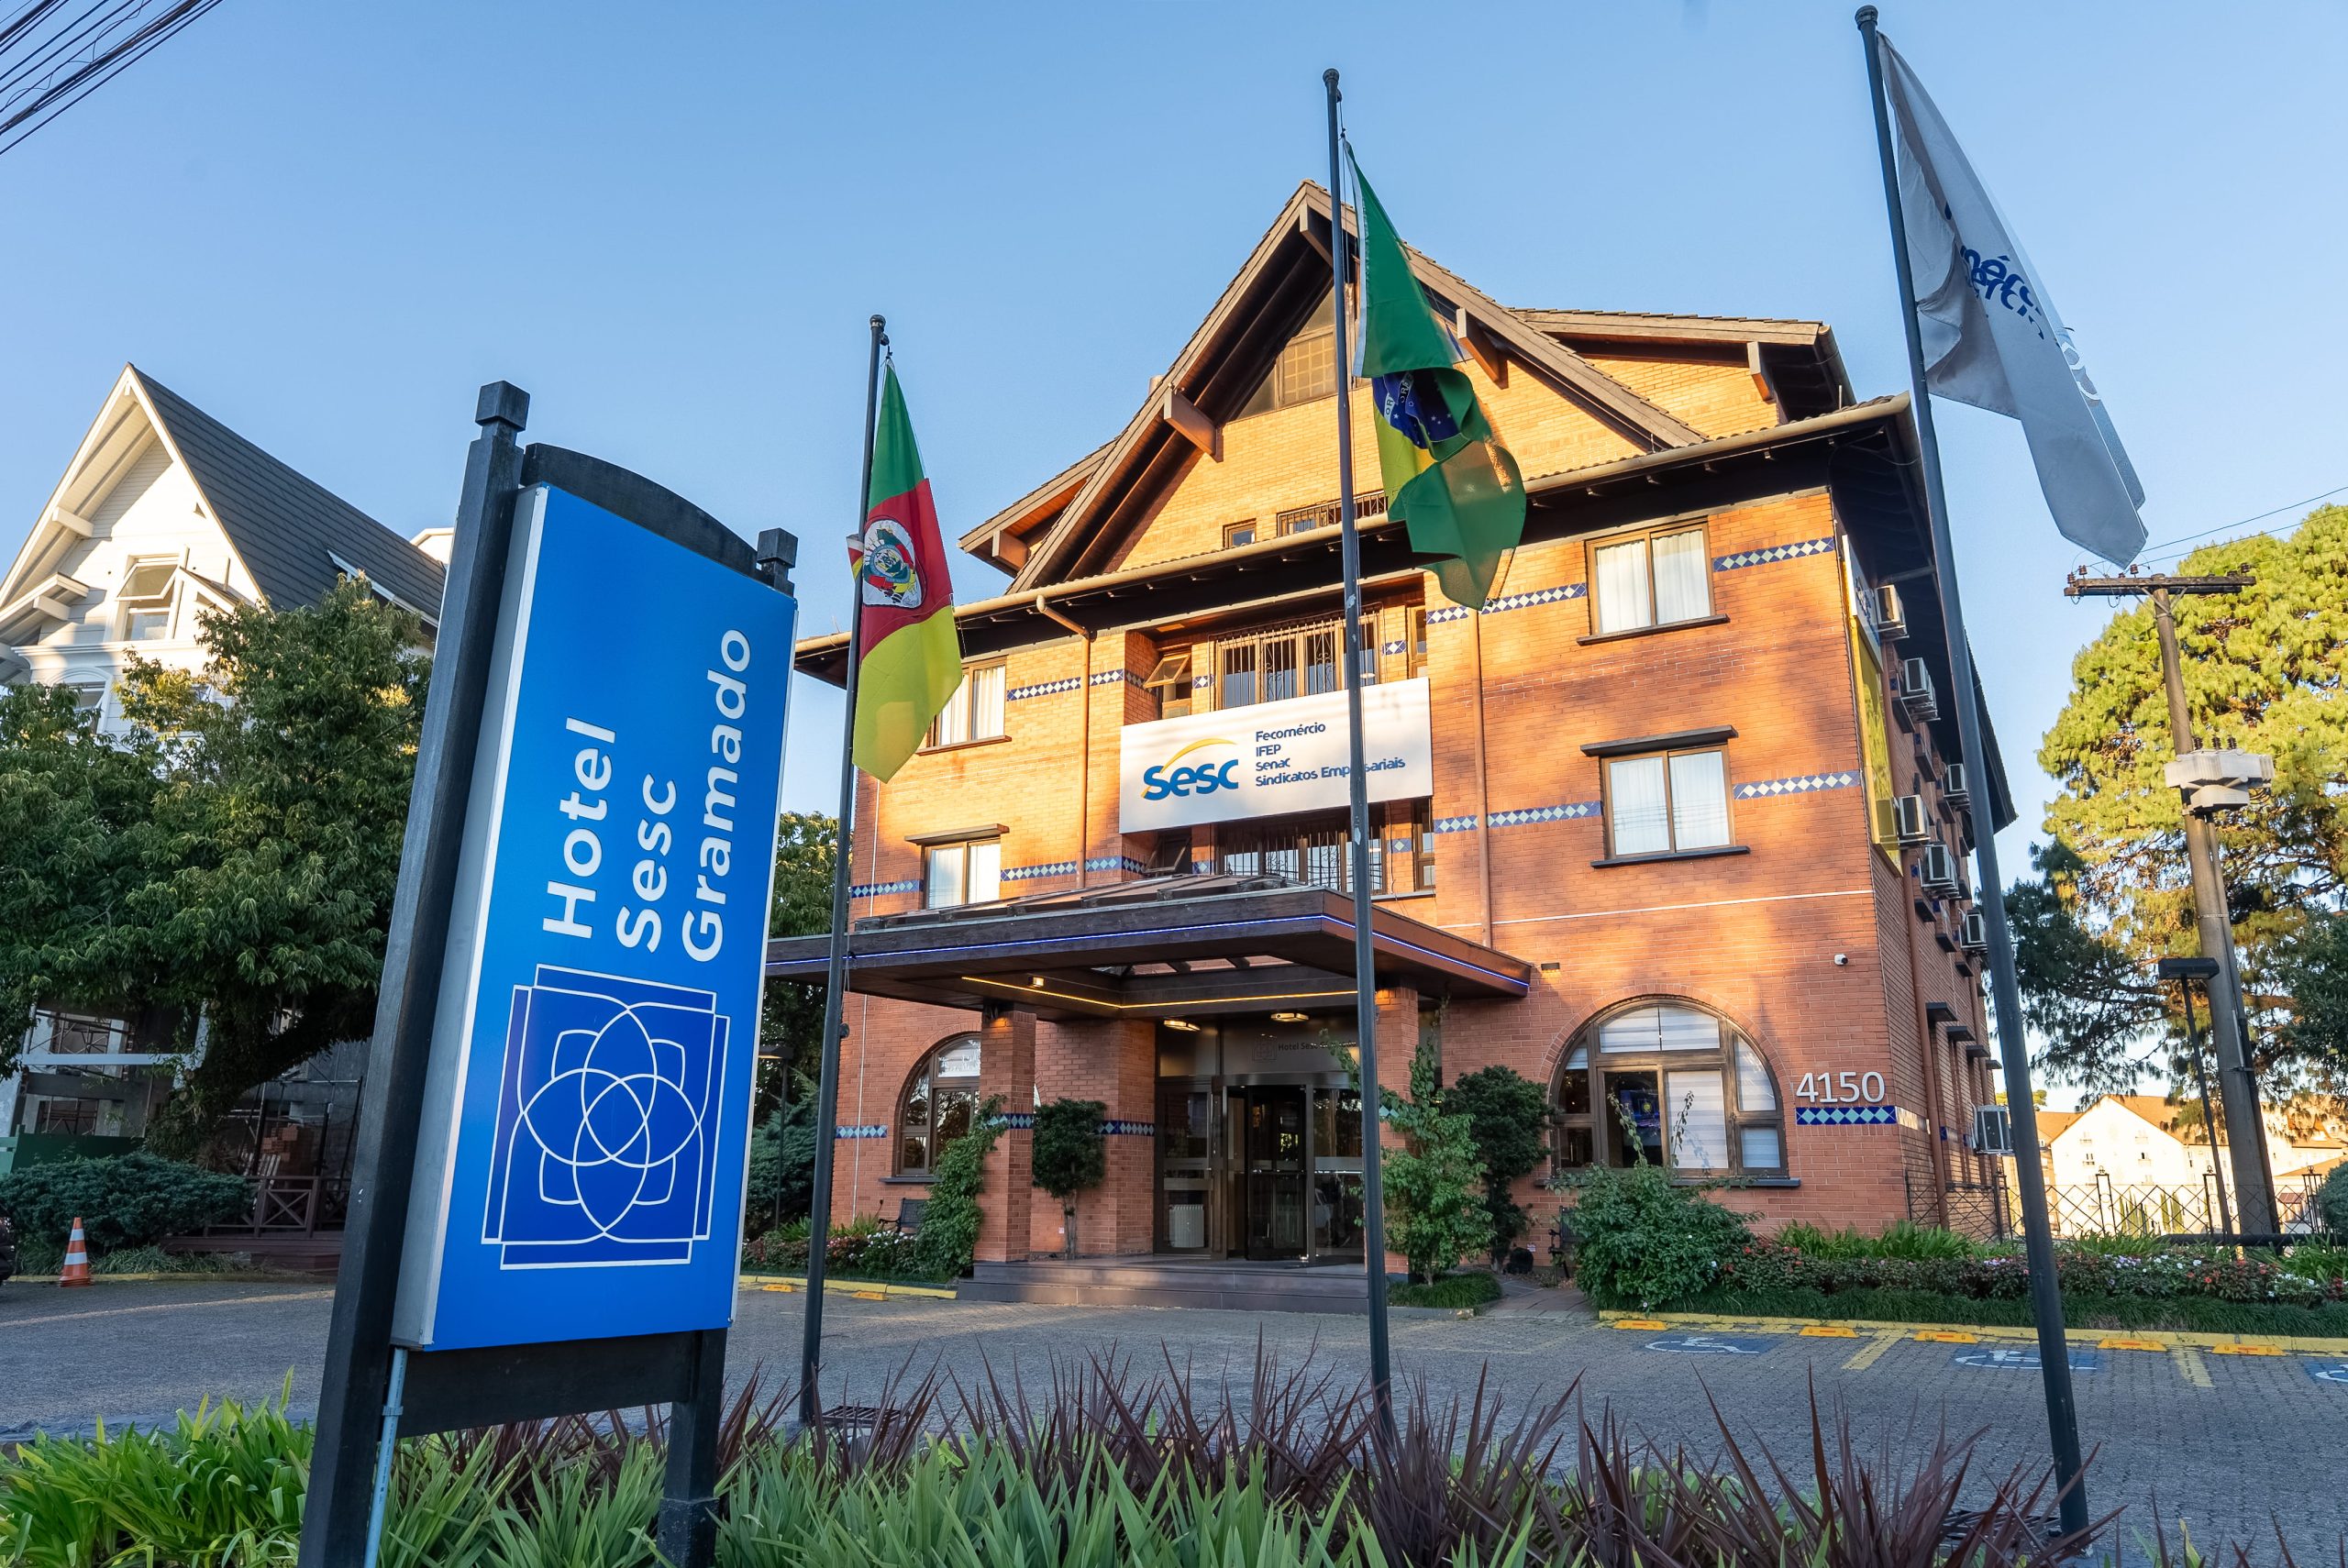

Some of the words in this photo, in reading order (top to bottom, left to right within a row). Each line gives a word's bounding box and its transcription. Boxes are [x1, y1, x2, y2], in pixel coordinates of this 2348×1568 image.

[1256, 723, 1326, 742] Fecomércio
[1256, 744, 1281, 756] IFEP
[1256, 757, 1290, 771] Senac
[1256, 769, 1318, 787] Sindicatos
[1321, 757, 1406, 778] Empsariais
[681, 629, 750, 962] Gramado
[542, 717, 616, 938] Hotel
[616, 774, 677, 954] Sesc
[1279, 1042, 1299, 1051] Hotel
[1796, 1071, 1885, 1103] 4150
